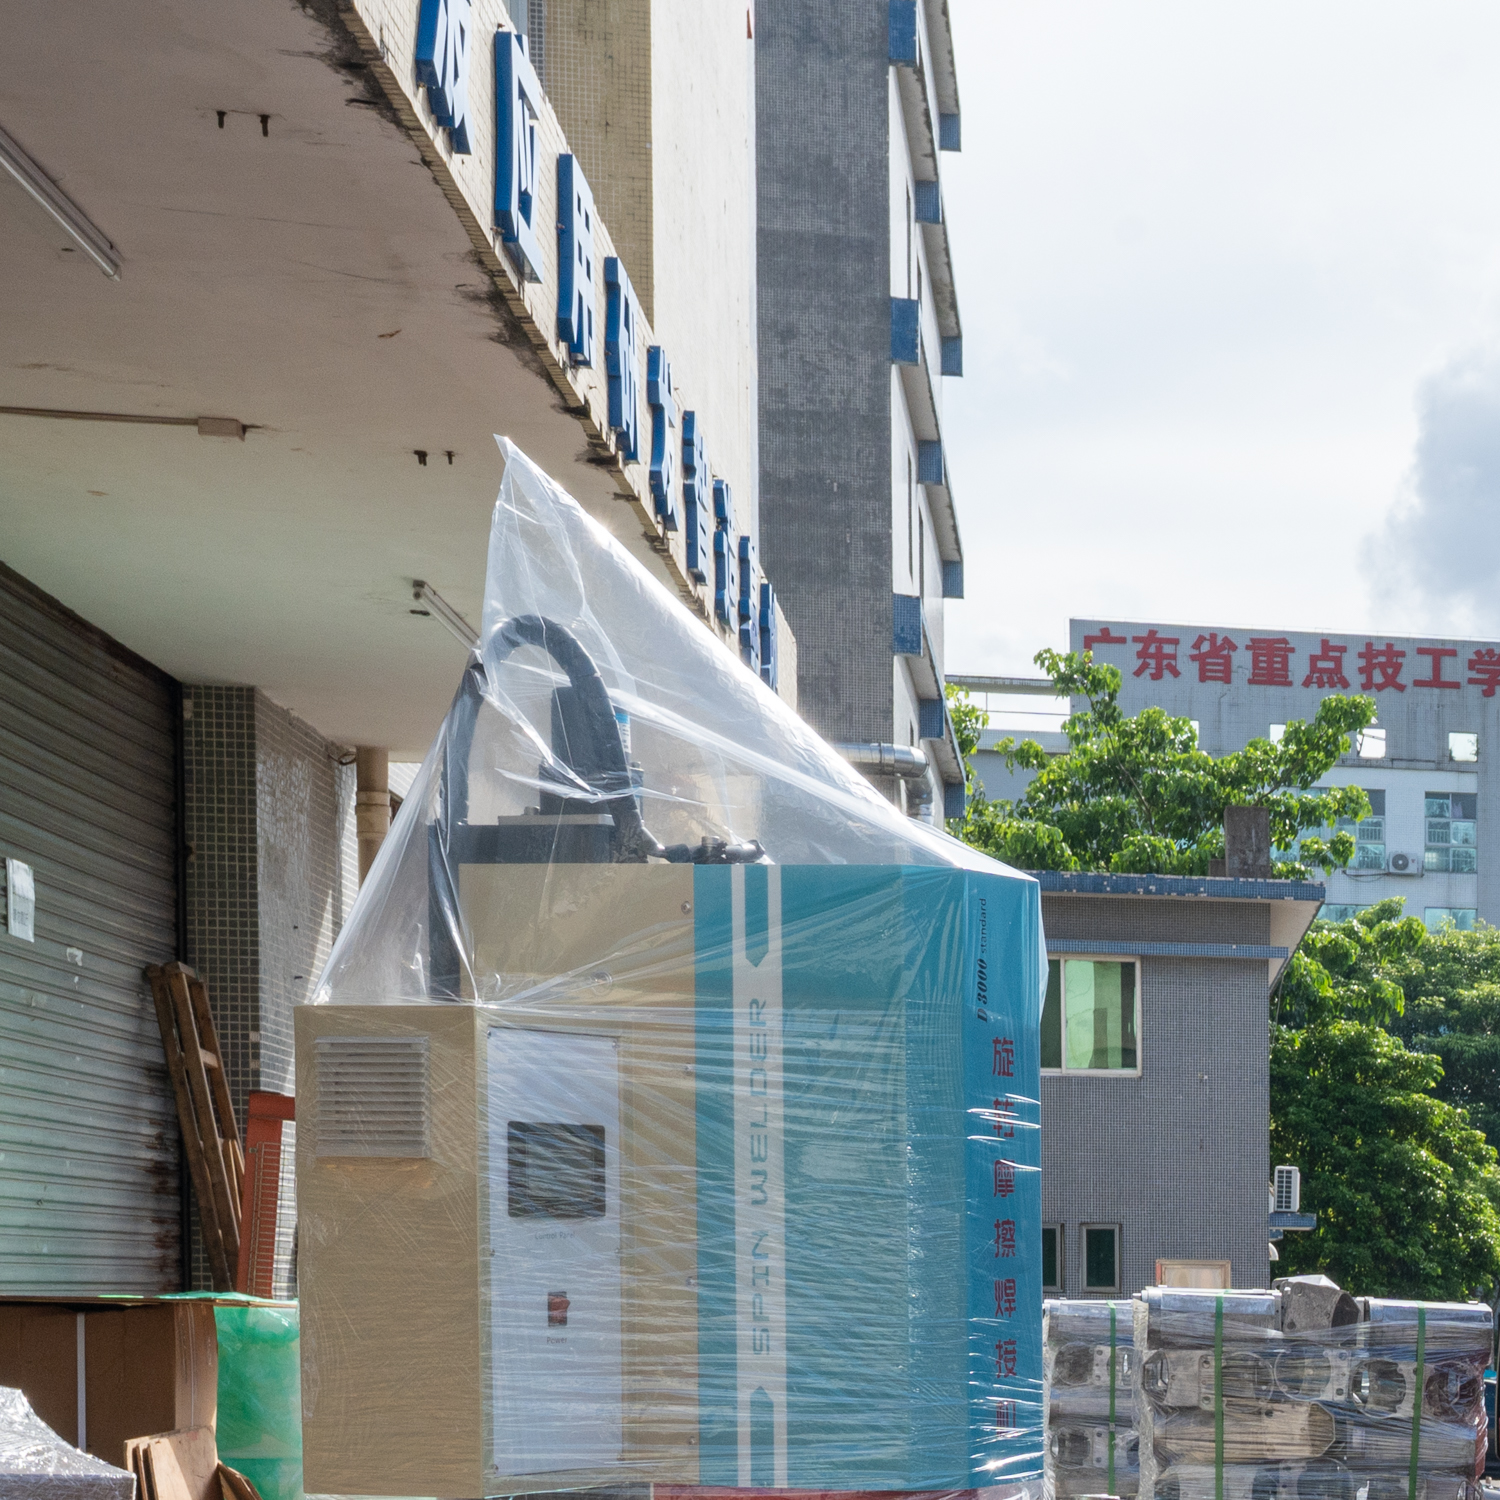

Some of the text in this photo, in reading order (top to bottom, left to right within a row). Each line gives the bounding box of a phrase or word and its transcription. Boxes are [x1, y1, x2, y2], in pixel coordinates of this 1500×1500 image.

[979, 898, 987, 953] standard
[977, 958, 987, 1004] 3000
[749, 998, 770, 1356] SPIN WELDER
[546, 1336, 568, 1344] Power
